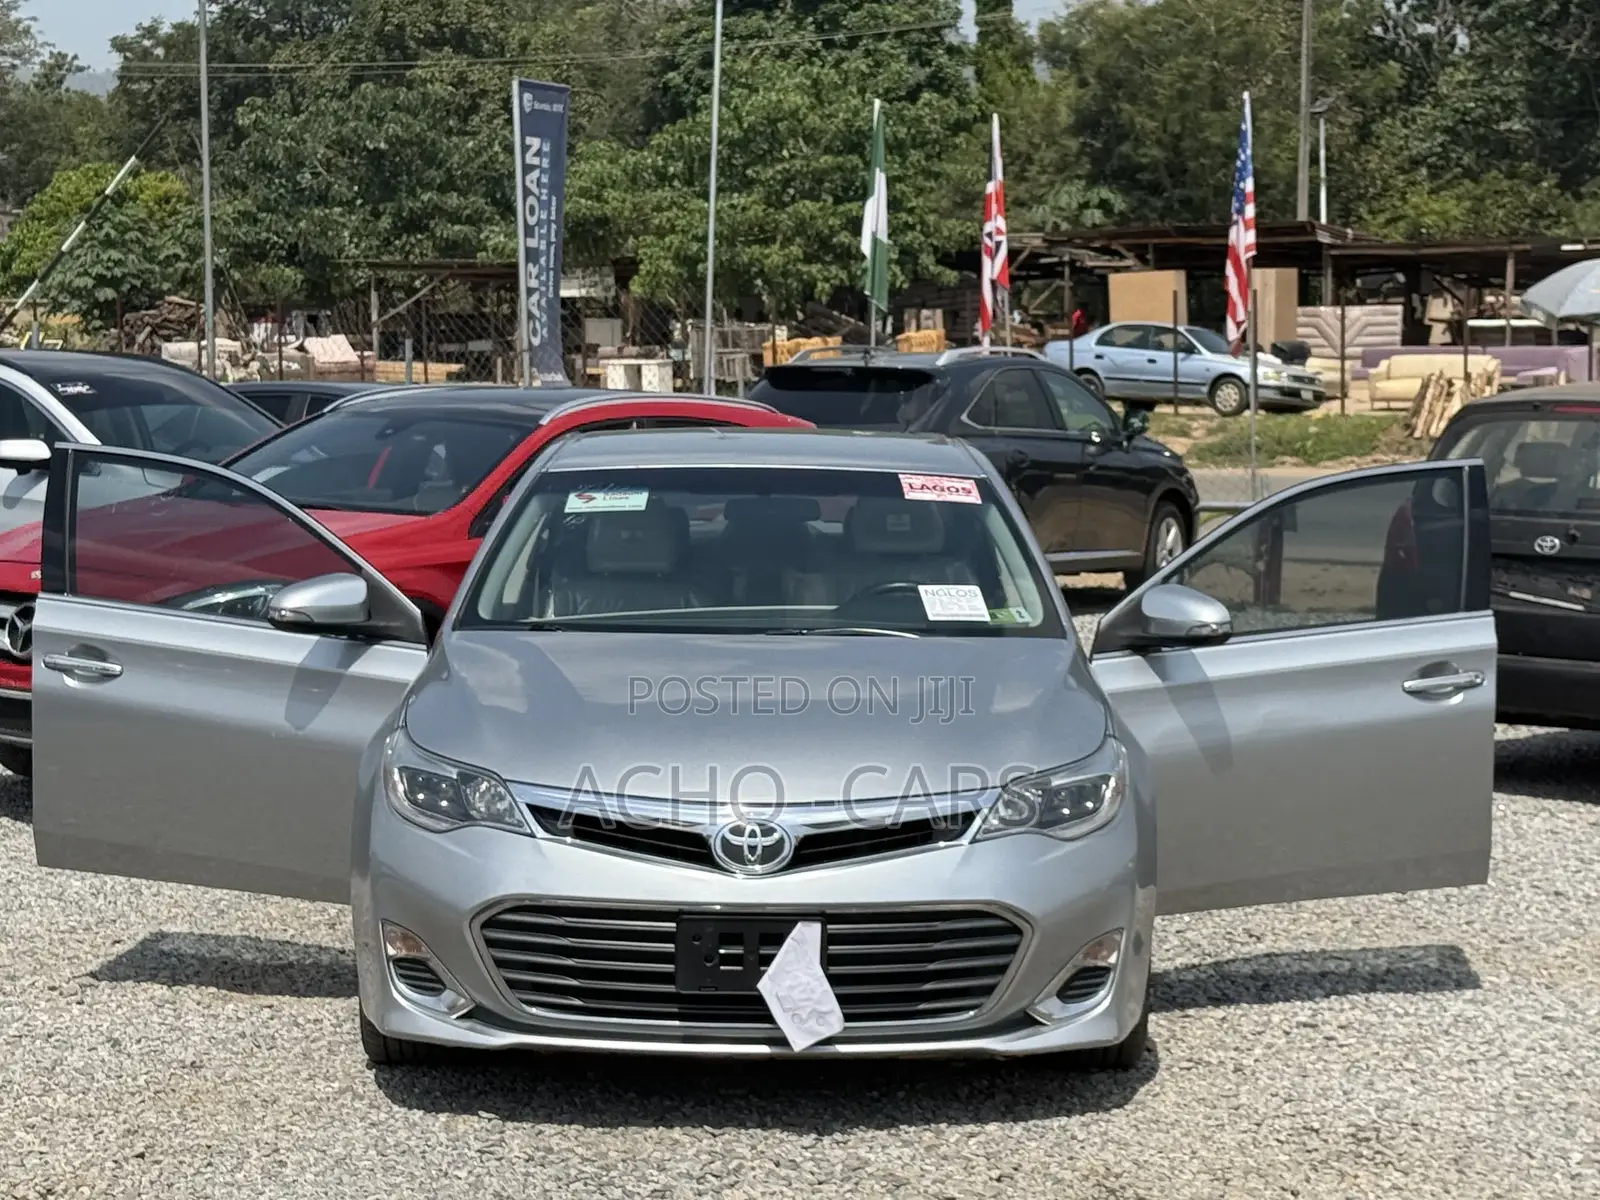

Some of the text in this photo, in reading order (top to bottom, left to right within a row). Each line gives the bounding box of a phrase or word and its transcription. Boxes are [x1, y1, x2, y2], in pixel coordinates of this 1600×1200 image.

[525, 136, 541, 346] CAR LOAN
[540, 140, 550, 338] AVAILABLE HERE
[908, 483, 972, 494] LAGOS
[924, 588, 978, 598] NGLOS
